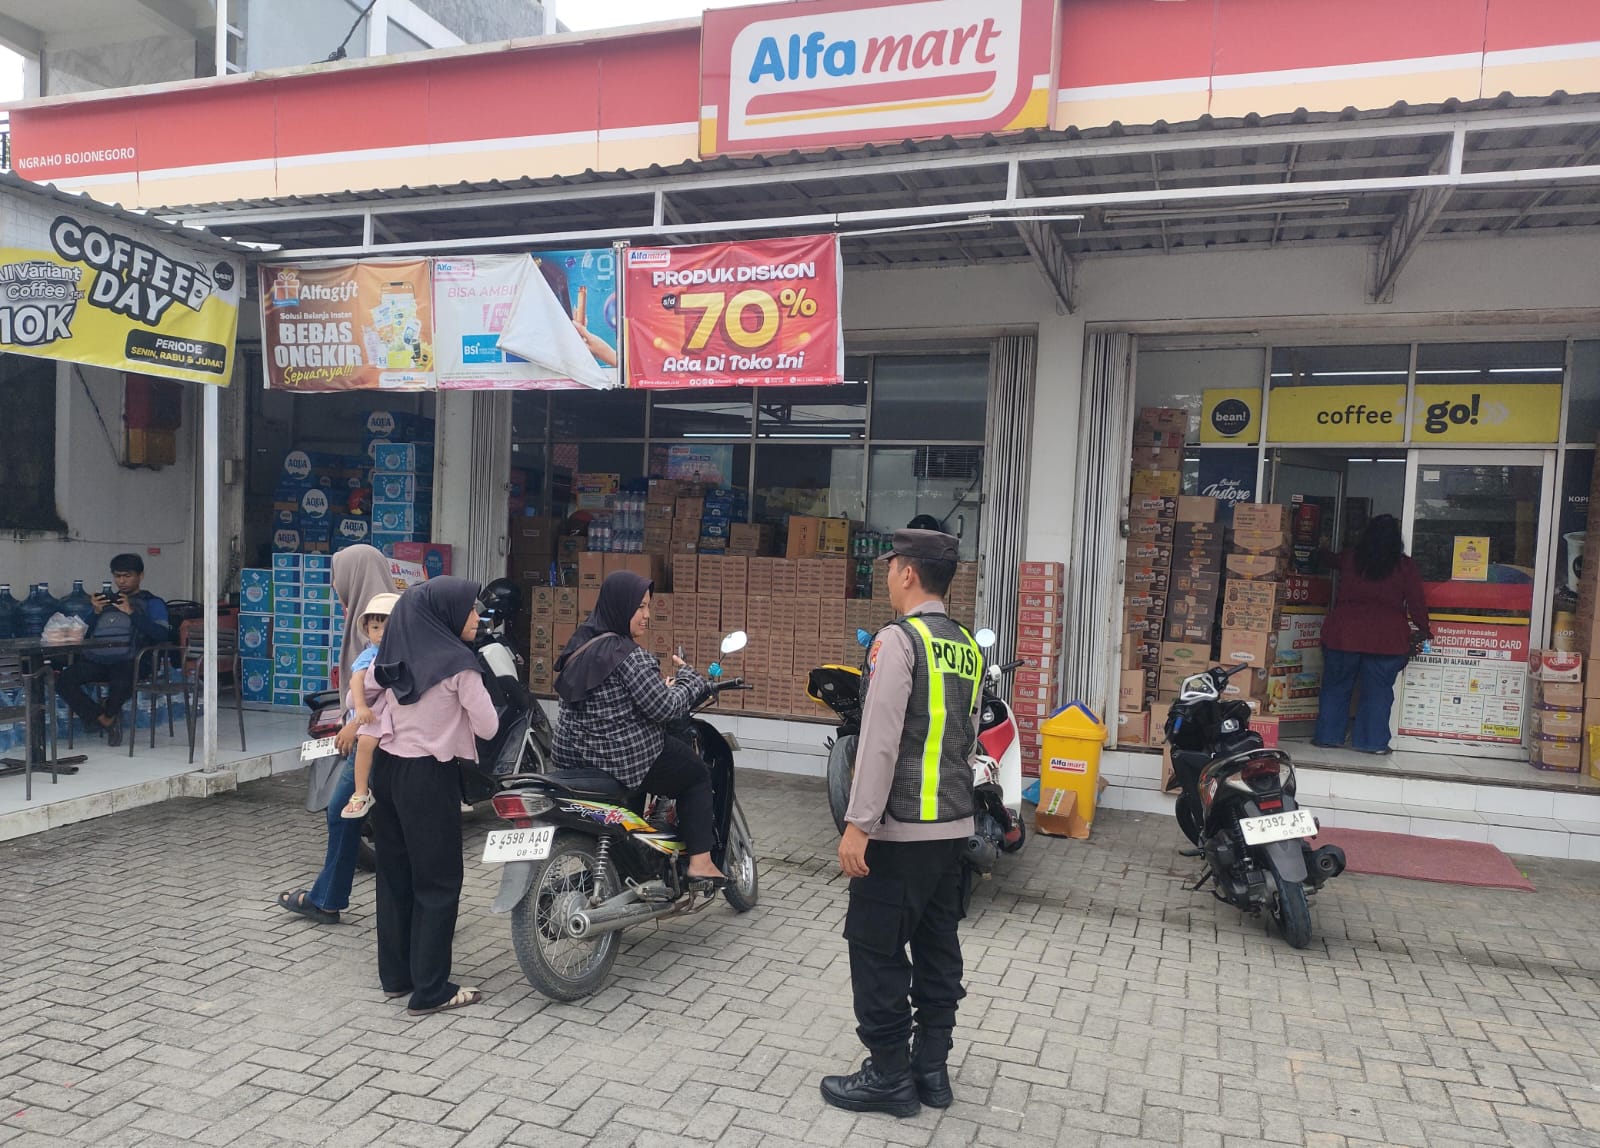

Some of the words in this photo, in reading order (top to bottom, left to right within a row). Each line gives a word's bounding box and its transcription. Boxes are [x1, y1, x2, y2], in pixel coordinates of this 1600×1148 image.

[748, 18, 1002, 84] Alfamart
[18, 154, 61, 169] NGRAHO
[64, 147, 136, 164] BOJONEGORO
[51, 217, 193, 301] COFFEE
[14, 262, 82, 282] Variant
[652, 267, 734, 287] PRODUK
[736, 261, 816, 283] DISKON
[7, 281, 66, 300] Coffee
[90, 270, 171, 324] DAY
[300, 280, 359, 302] Alfagift
[447, 287, 476, 299] BISA
[0, 305, 74, 345] 10K
[280, 312, 303, 320] Solusi
[303, 312, 330, 321] Belanja
[279, 321, 353, 344] BEBAS
[130, 346, 159, 360] SENIN,
[159, 351, 185, 364] RABU
[155, 338, 203, 355] PERIODE
[273, 344, 363, 368] ONGKIR
[464, 344, 481, 355] BSI
[662, 355, 701, 373] Ada
[704, 353, 725, 372] Di
[728, 353, 773, 372] Toko
[774, 352, 805, 370] Ini
[370, 415, 392, 428] AQUA
[1214, 411, 1247, 423] bean!
[1316, 404, 1394, 425] coffee
[1424, 393, 1481, 434] go!
[304, 497, 327, 507] AQUA
[1201, 483, 1252, 502] Instore
[1568, 495, 1589, 503] KOPI
[343, 521, 366, 532] AQUA
[1437, 626, 1466, 637] Melayani
[1499, 638, 1522, 650] CARD
[1051, 759, 1086, 769] Alfamart
[1245, 821, 1254, 832] S
[1257, 816, 1286, 831] 2392
[1291, 812, 1306, 827] AF
[489, 834, 497, 846] S
[500, 832, 525, 846] 4598
